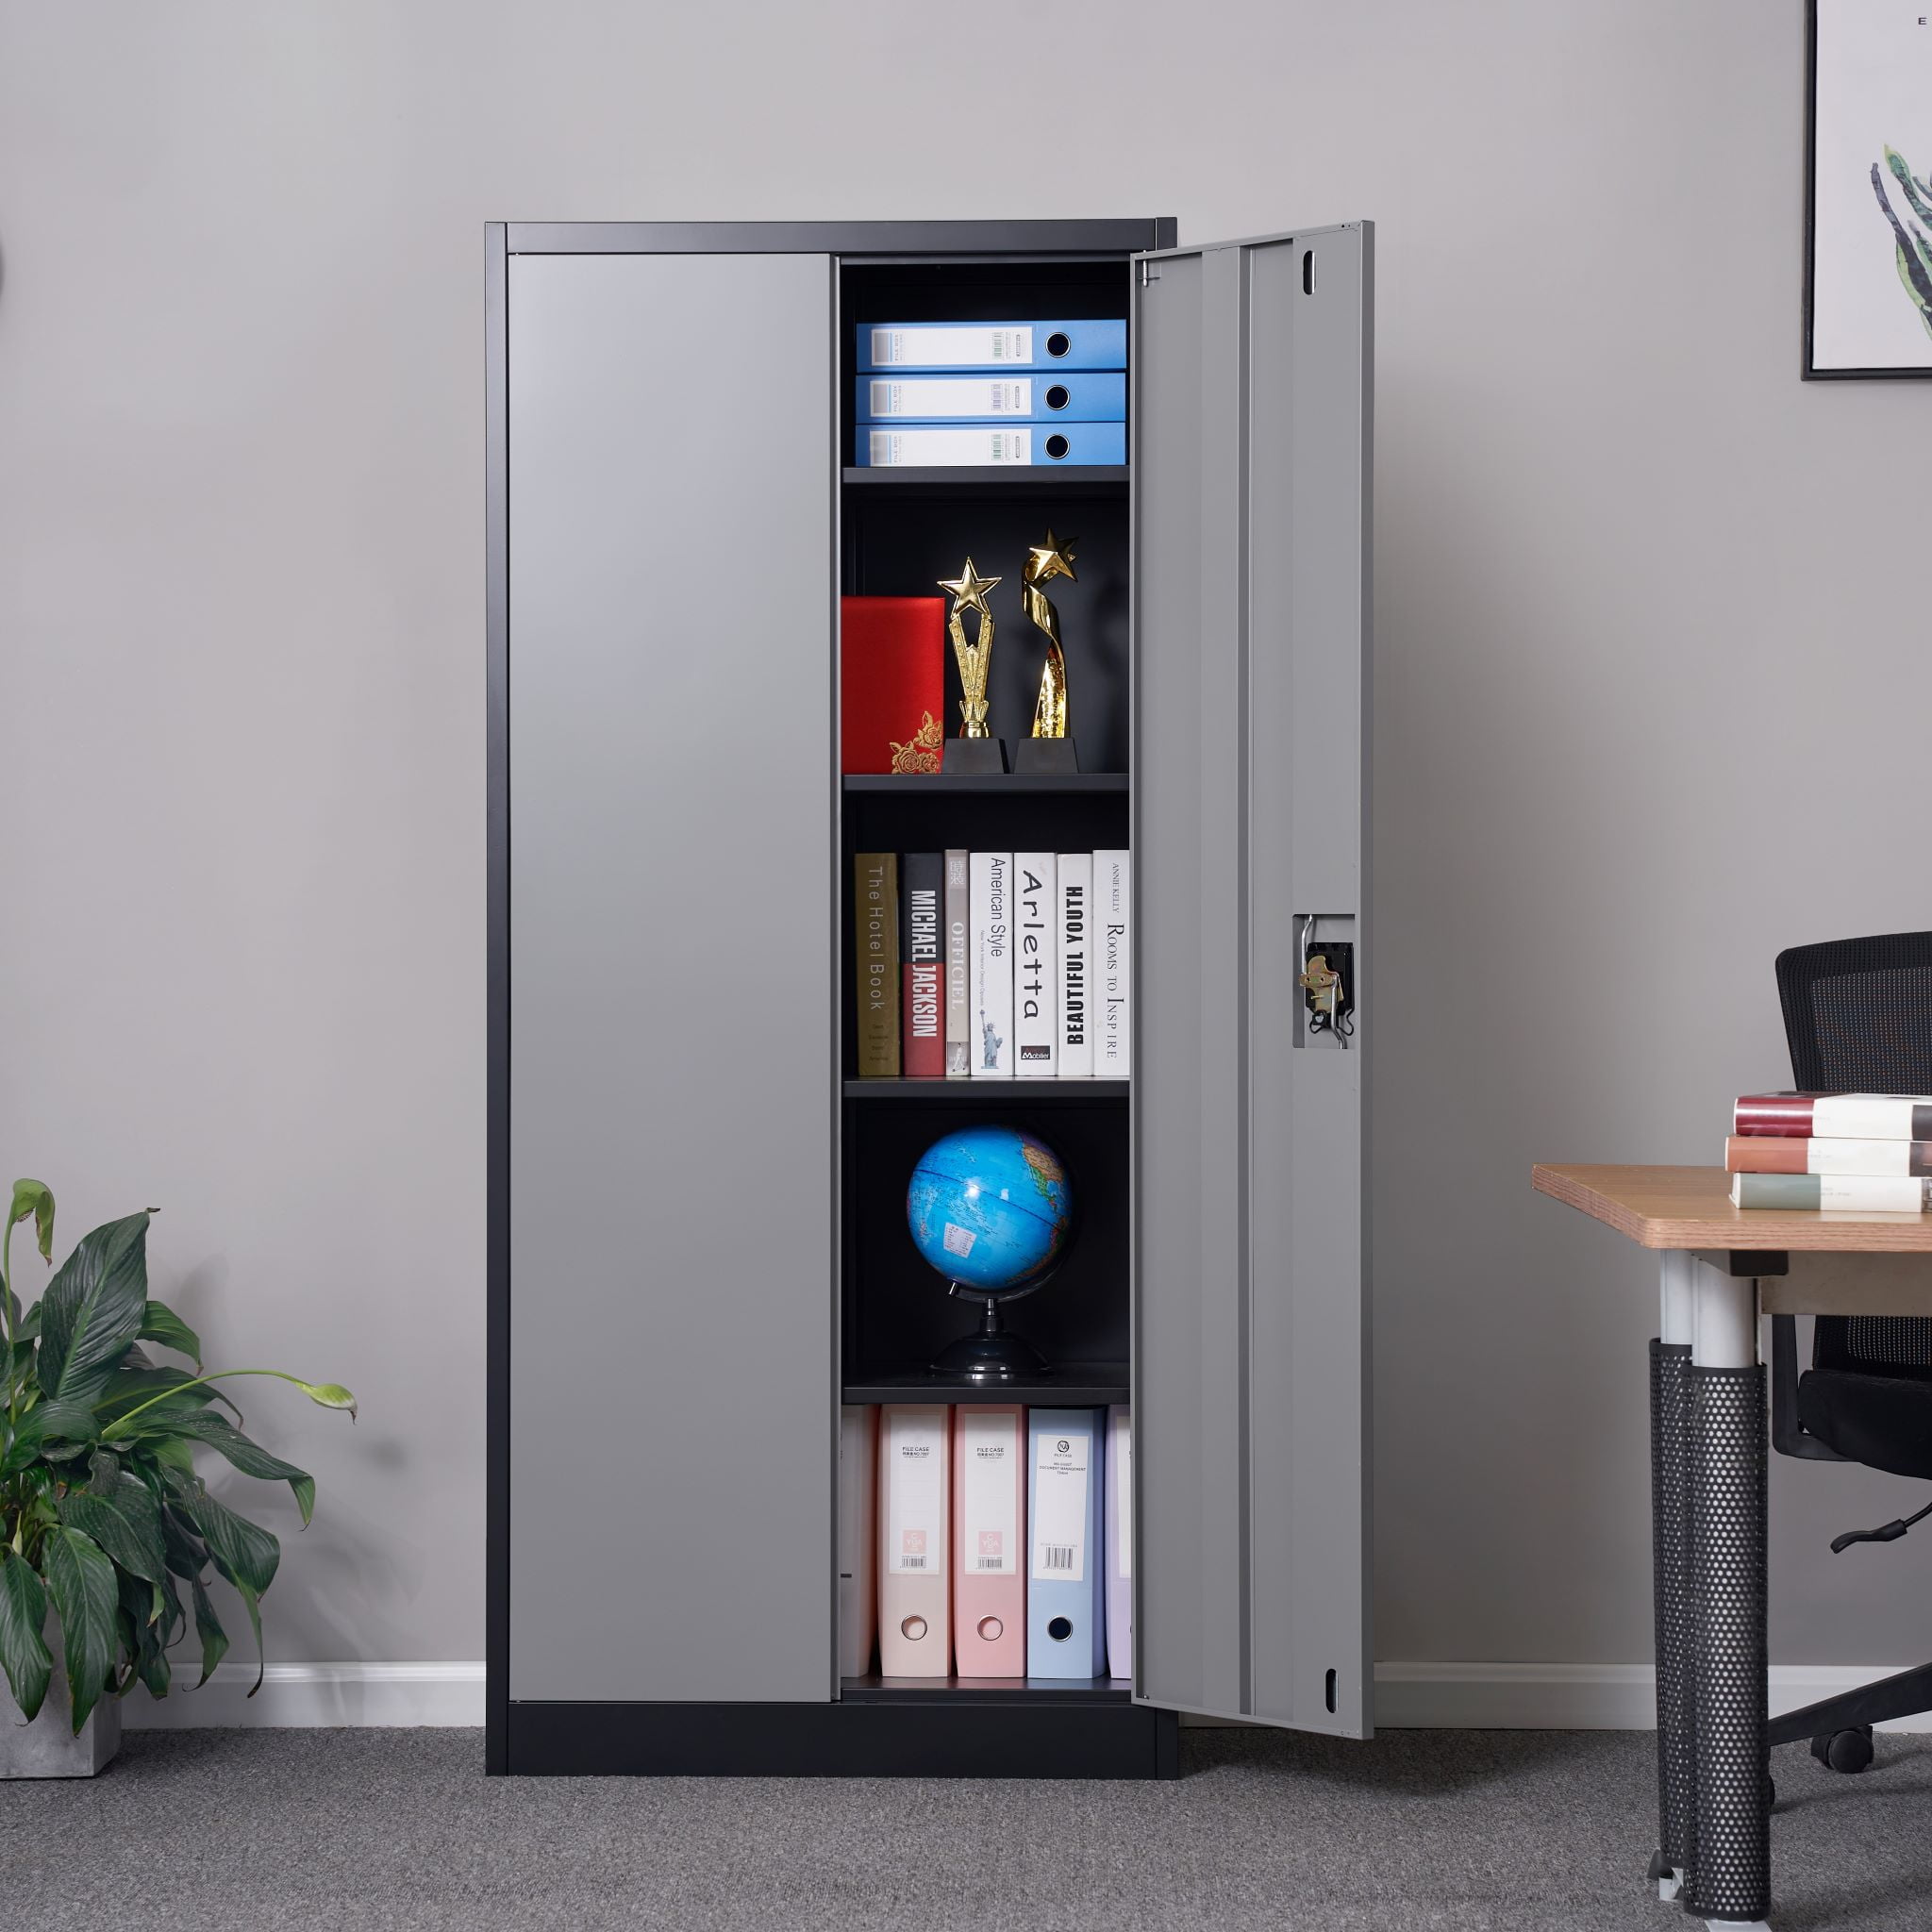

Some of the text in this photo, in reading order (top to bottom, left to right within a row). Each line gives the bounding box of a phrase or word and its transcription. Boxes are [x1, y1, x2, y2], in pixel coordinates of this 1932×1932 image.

[868, 866, 883, 900] The
[869, 908, 884, 958] Hotel
[987, 858, 1007, 958] American Style
[870, 964, 885, 1010] Book
[911, 890, 937, 1037] MICHAEL JACKSON
[951, 921, 964, 1009] OFFICIEL
[1023, 870, 1044, 1019] Arletta
[1066, 886, 1084, 1044] BEAUTIFUL YOUTH
[1107, 923, 1124, 1058] ROOMS TO INSPIRE
